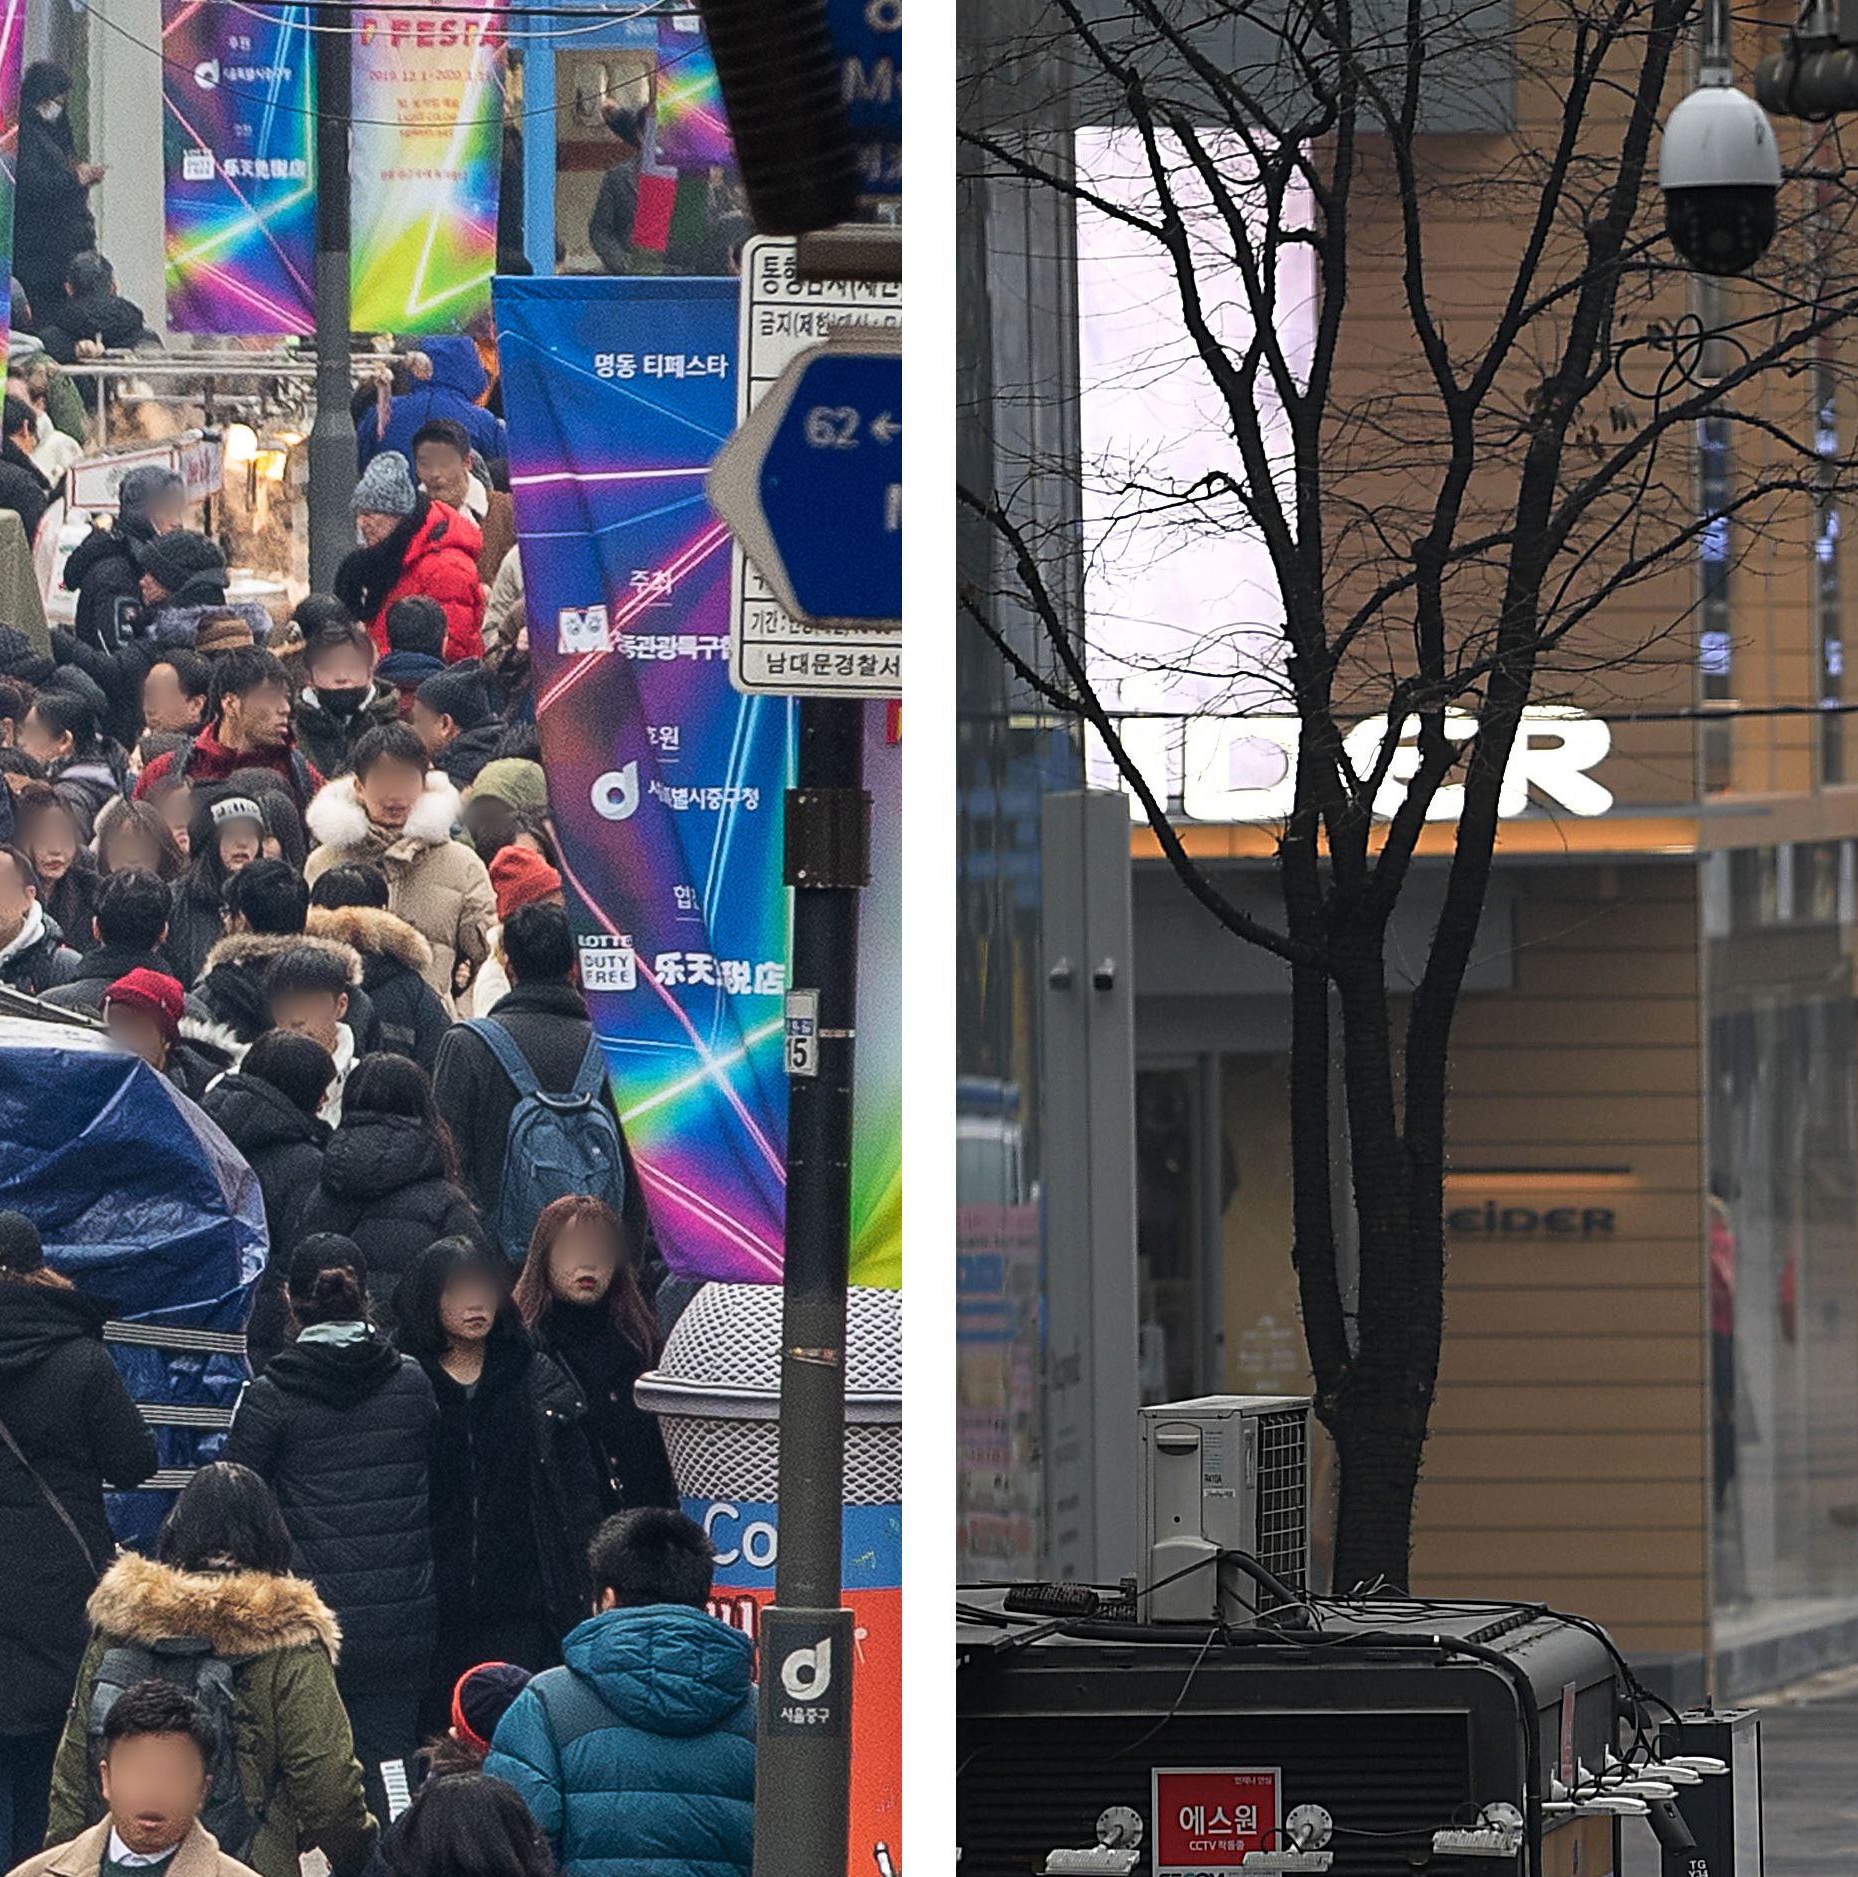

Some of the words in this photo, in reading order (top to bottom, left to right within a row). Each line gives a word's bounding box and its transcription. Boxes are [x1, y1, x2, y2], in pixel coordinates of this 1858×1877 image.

[594, 353, 637, 379] 명동
[642, 353, 730, 379] 티페스타
[805, 406, 858, 449] 62
[766, 653, 901, 680] 남대문경찰서
[578, 934, 634, 949] LOTTE
[584, 955, 630, 969] DUTY
[585, 970, 631, 985] FREE
[654, 950, 787, 996] 乐天税店
[780, 1707, 830, 1725] 서울중구
[1179, 1804, 1258, 1837] 에스원
[1189, 1840, 1217, 1852] CCTV
[1689, 1859, 1707, 1870] TG
